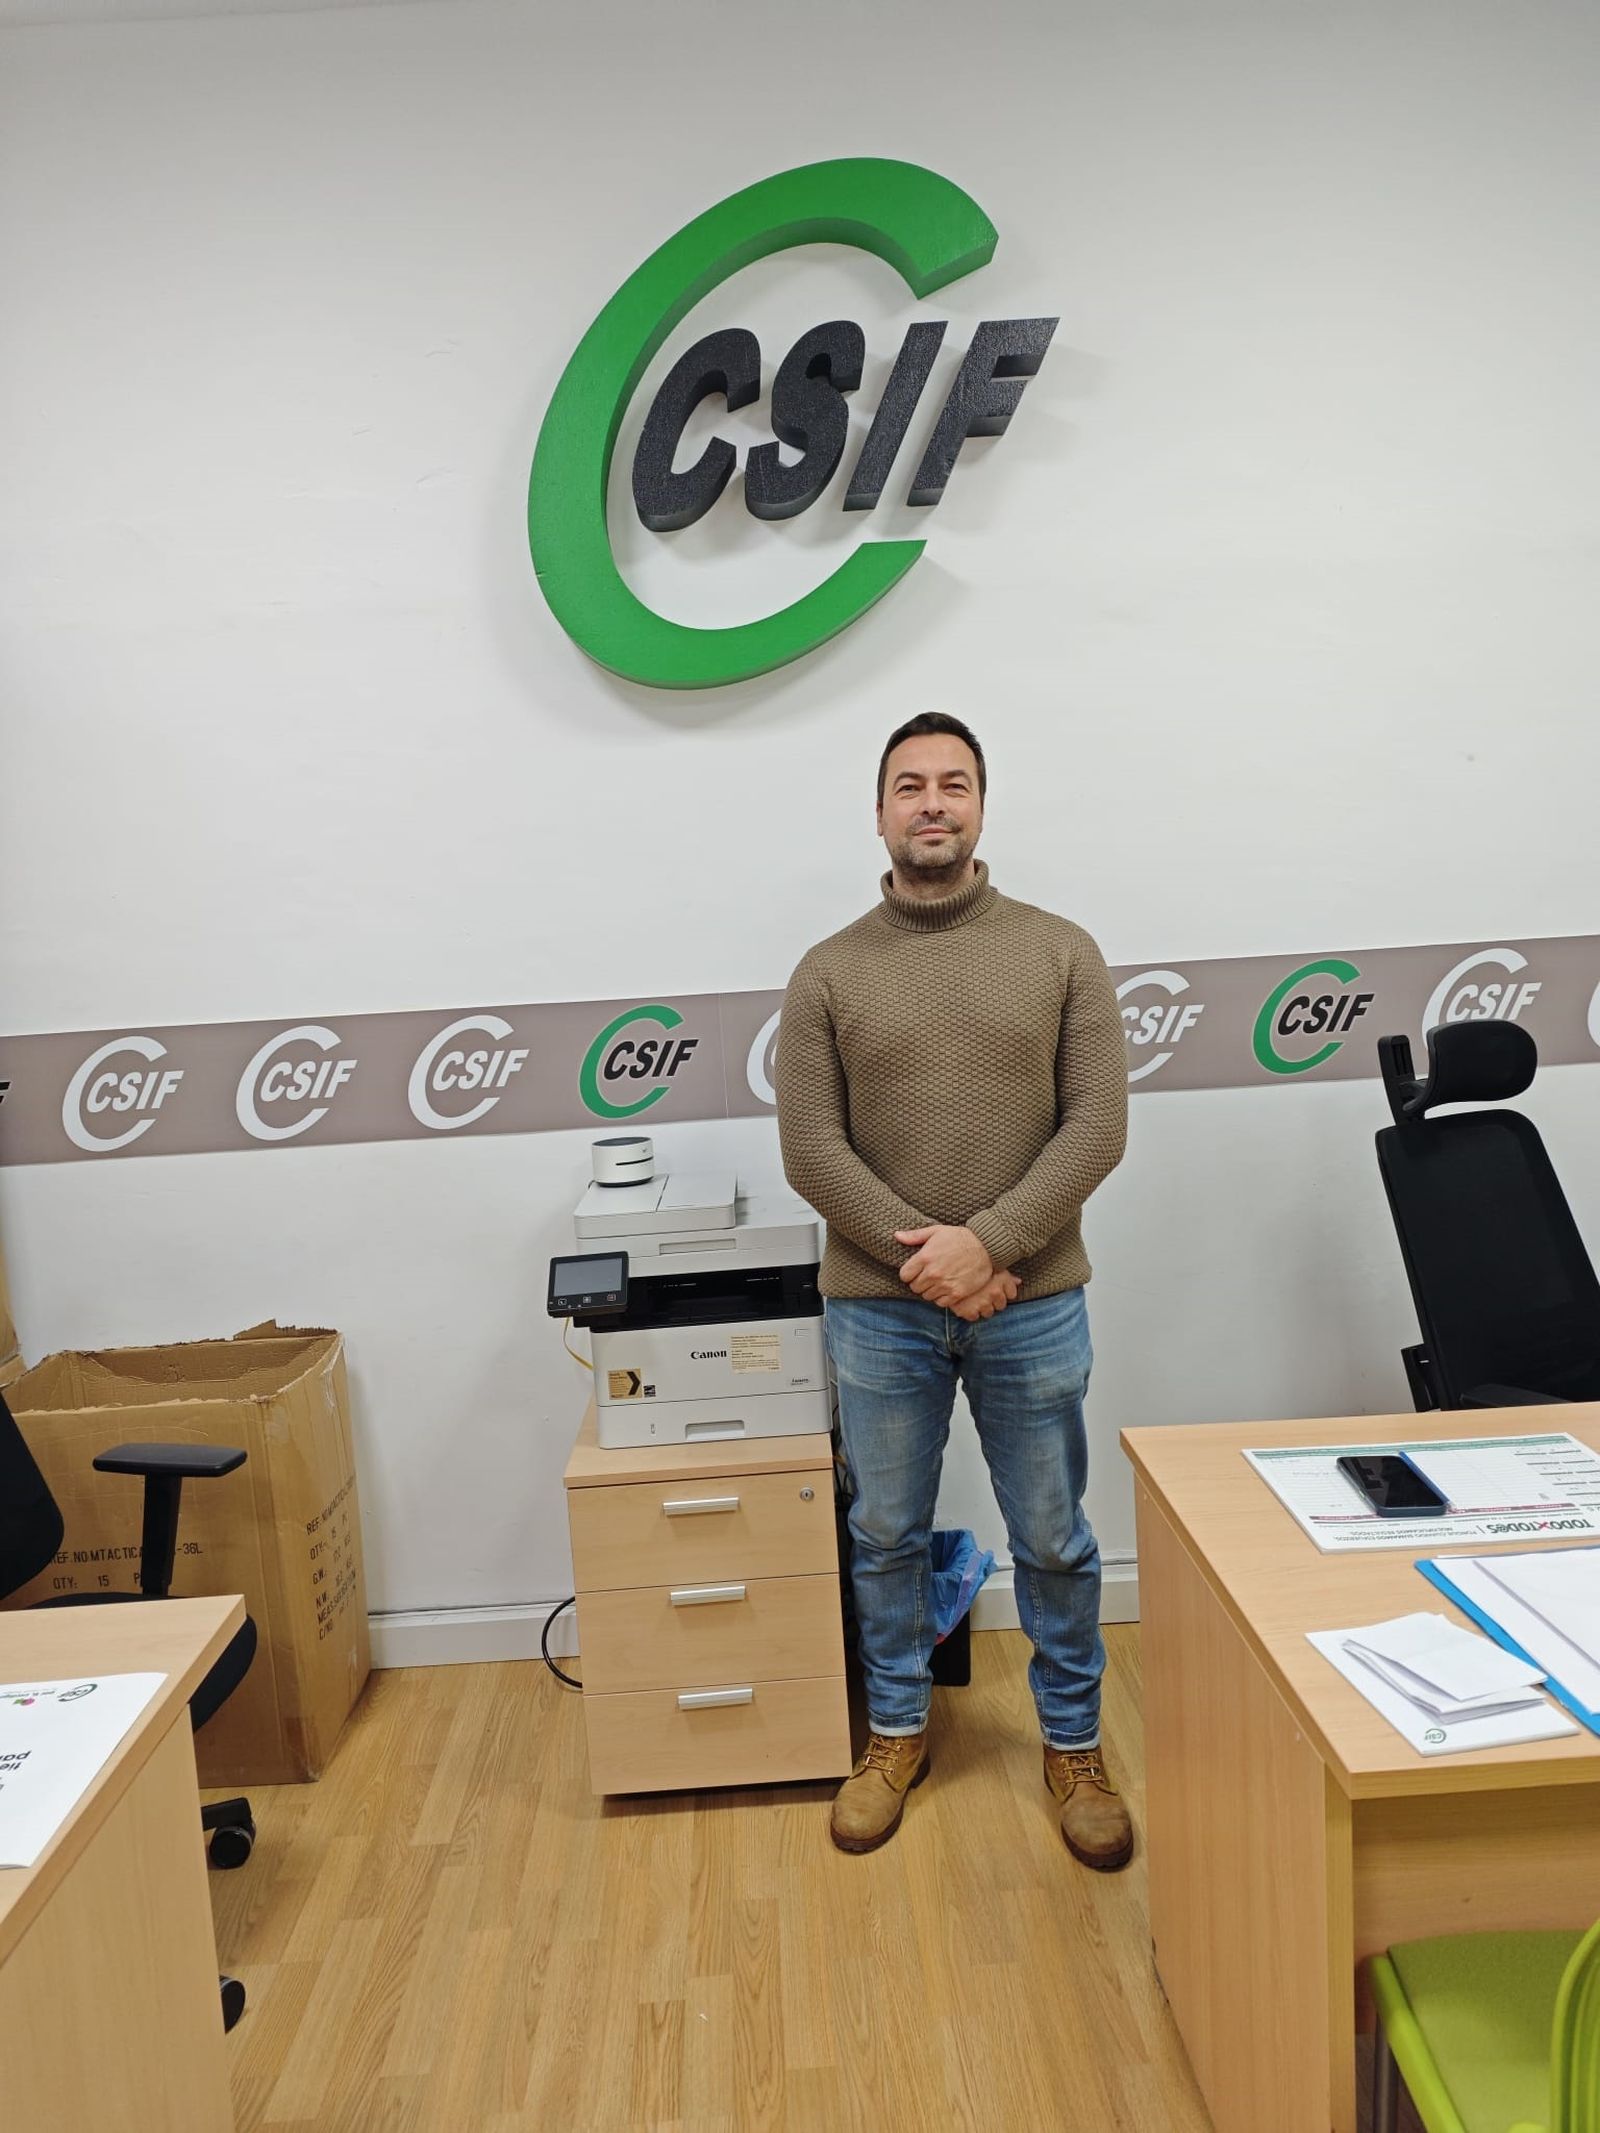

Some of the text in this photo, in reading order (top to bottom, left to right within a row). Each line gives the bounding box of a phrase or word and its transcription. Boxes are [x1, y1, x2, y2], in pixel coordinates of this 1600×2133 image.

[632, 317, 1060, 532] CSIF
[1278, 993, 1375, 1036] CSIF
[1446, 982, 1542, 1023] CSIF
[261, 1059, 358, 1102] CSIF
[433, 1049, 530, 1092] CSIF
[603, 1038, 699, 1080] CSIF
[87, 1070, 184, 1113] CSIF
[690, 1350, 727, 1360] Canon
[98, 1575, 109, 1587] 15
